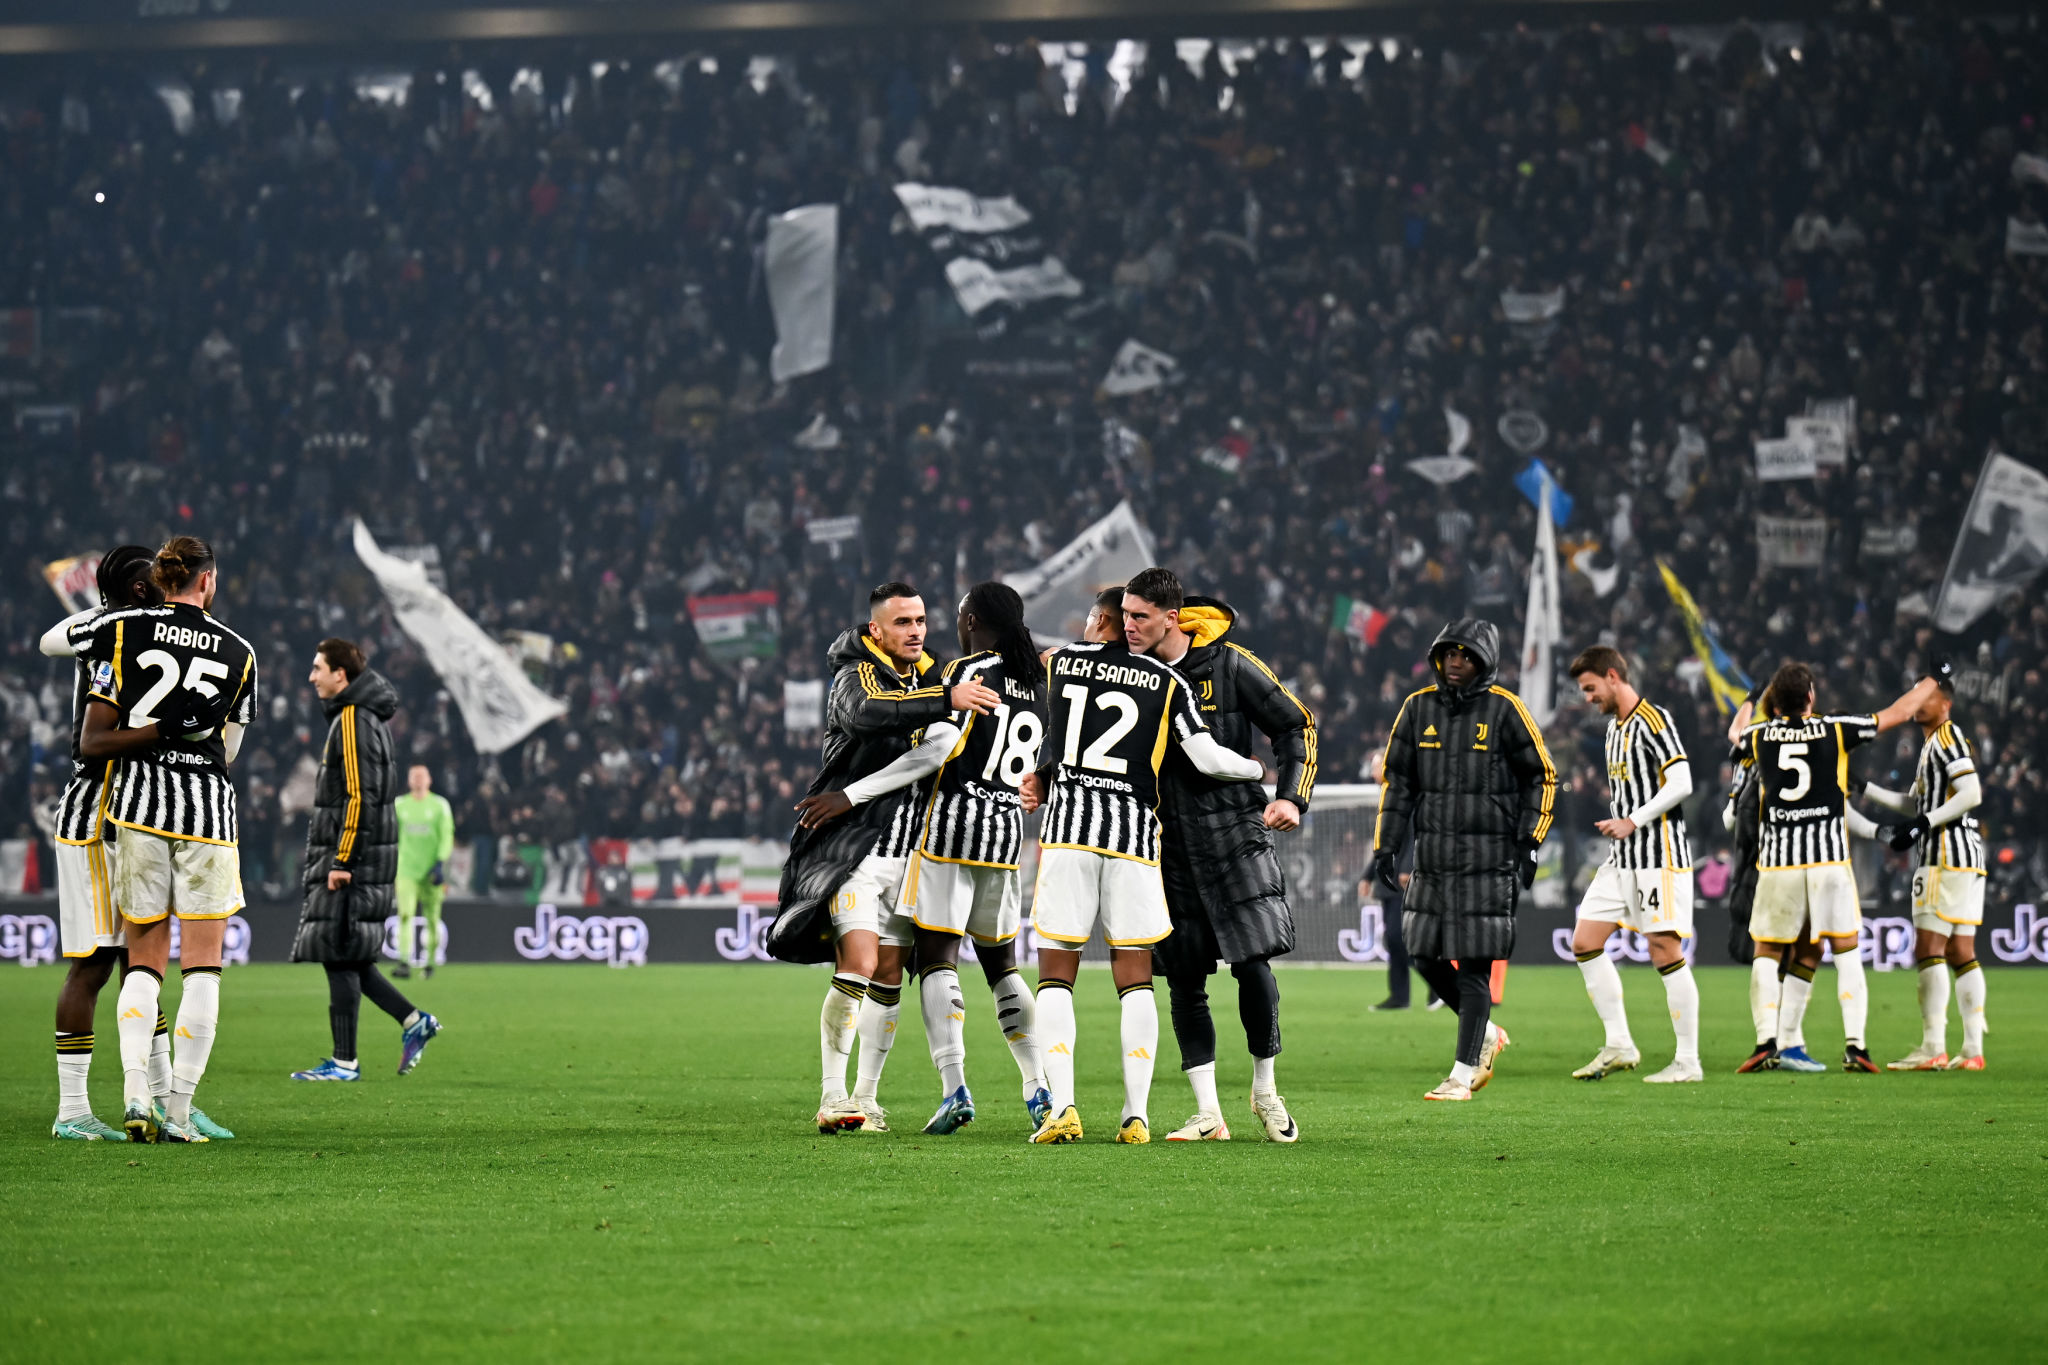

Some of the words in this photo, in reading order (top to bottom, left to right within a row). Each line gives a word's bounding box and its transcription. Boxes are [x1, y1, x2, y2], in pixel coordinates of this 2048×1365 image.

[153, 622, 222, 653] RABIOT
[128, 649, 229, 742] 25
[1055, 656, 1094, 678] ALEX
[1095, 662, 1161, 691] SANDRO
[981, 703, 1043, 788] 18
[1061, 683, 1140, 775] 12
[1763, 723, 1827, 742] LOCATELLI
[1777, 742, 1812, 802] 5
[1776, 805, 1830, 822] Cygames
[514, 903, 649, 968] Jeep
